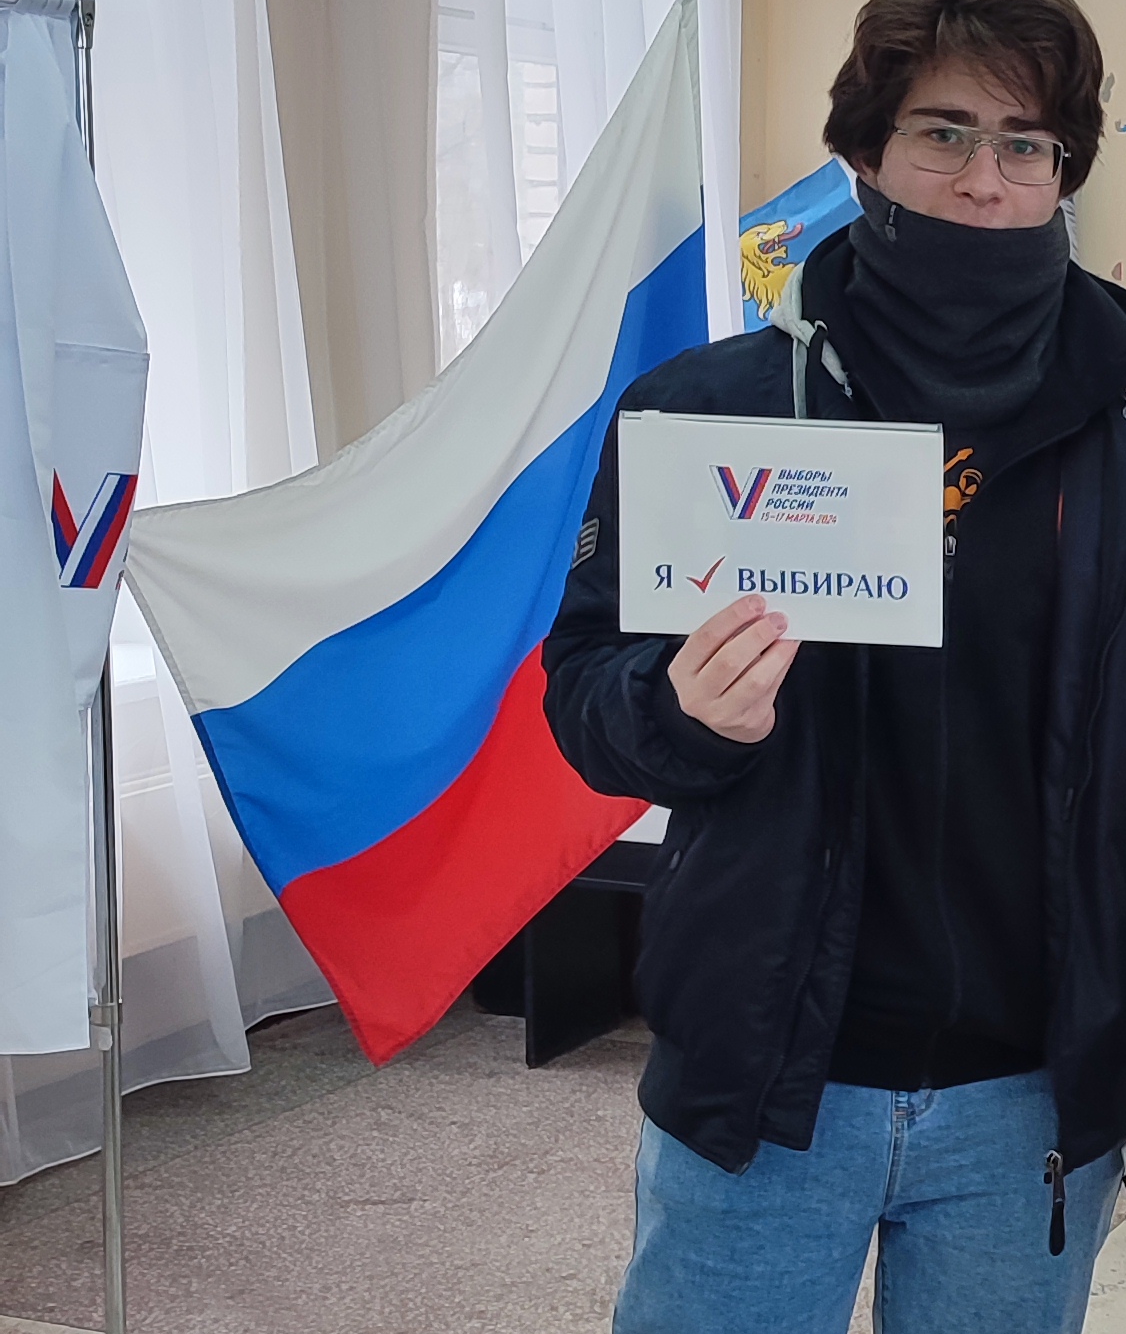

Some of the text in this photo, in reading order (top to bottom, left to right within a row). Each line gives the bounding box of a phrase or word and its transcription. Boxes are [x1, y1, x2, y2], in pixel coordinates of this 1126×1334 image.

[777, 469, 833, 482] ВЫБОРЫ
[771, 483, 849, 498] ПРЕЗИДЕНТА
[765, 498, 815, 511] РОССИИ
[785, 513, 815, 524] МАРТА
[815, 514, 838, 525] 2024
[654, 564, 909, 600] Я ВЫБИРАЮ
